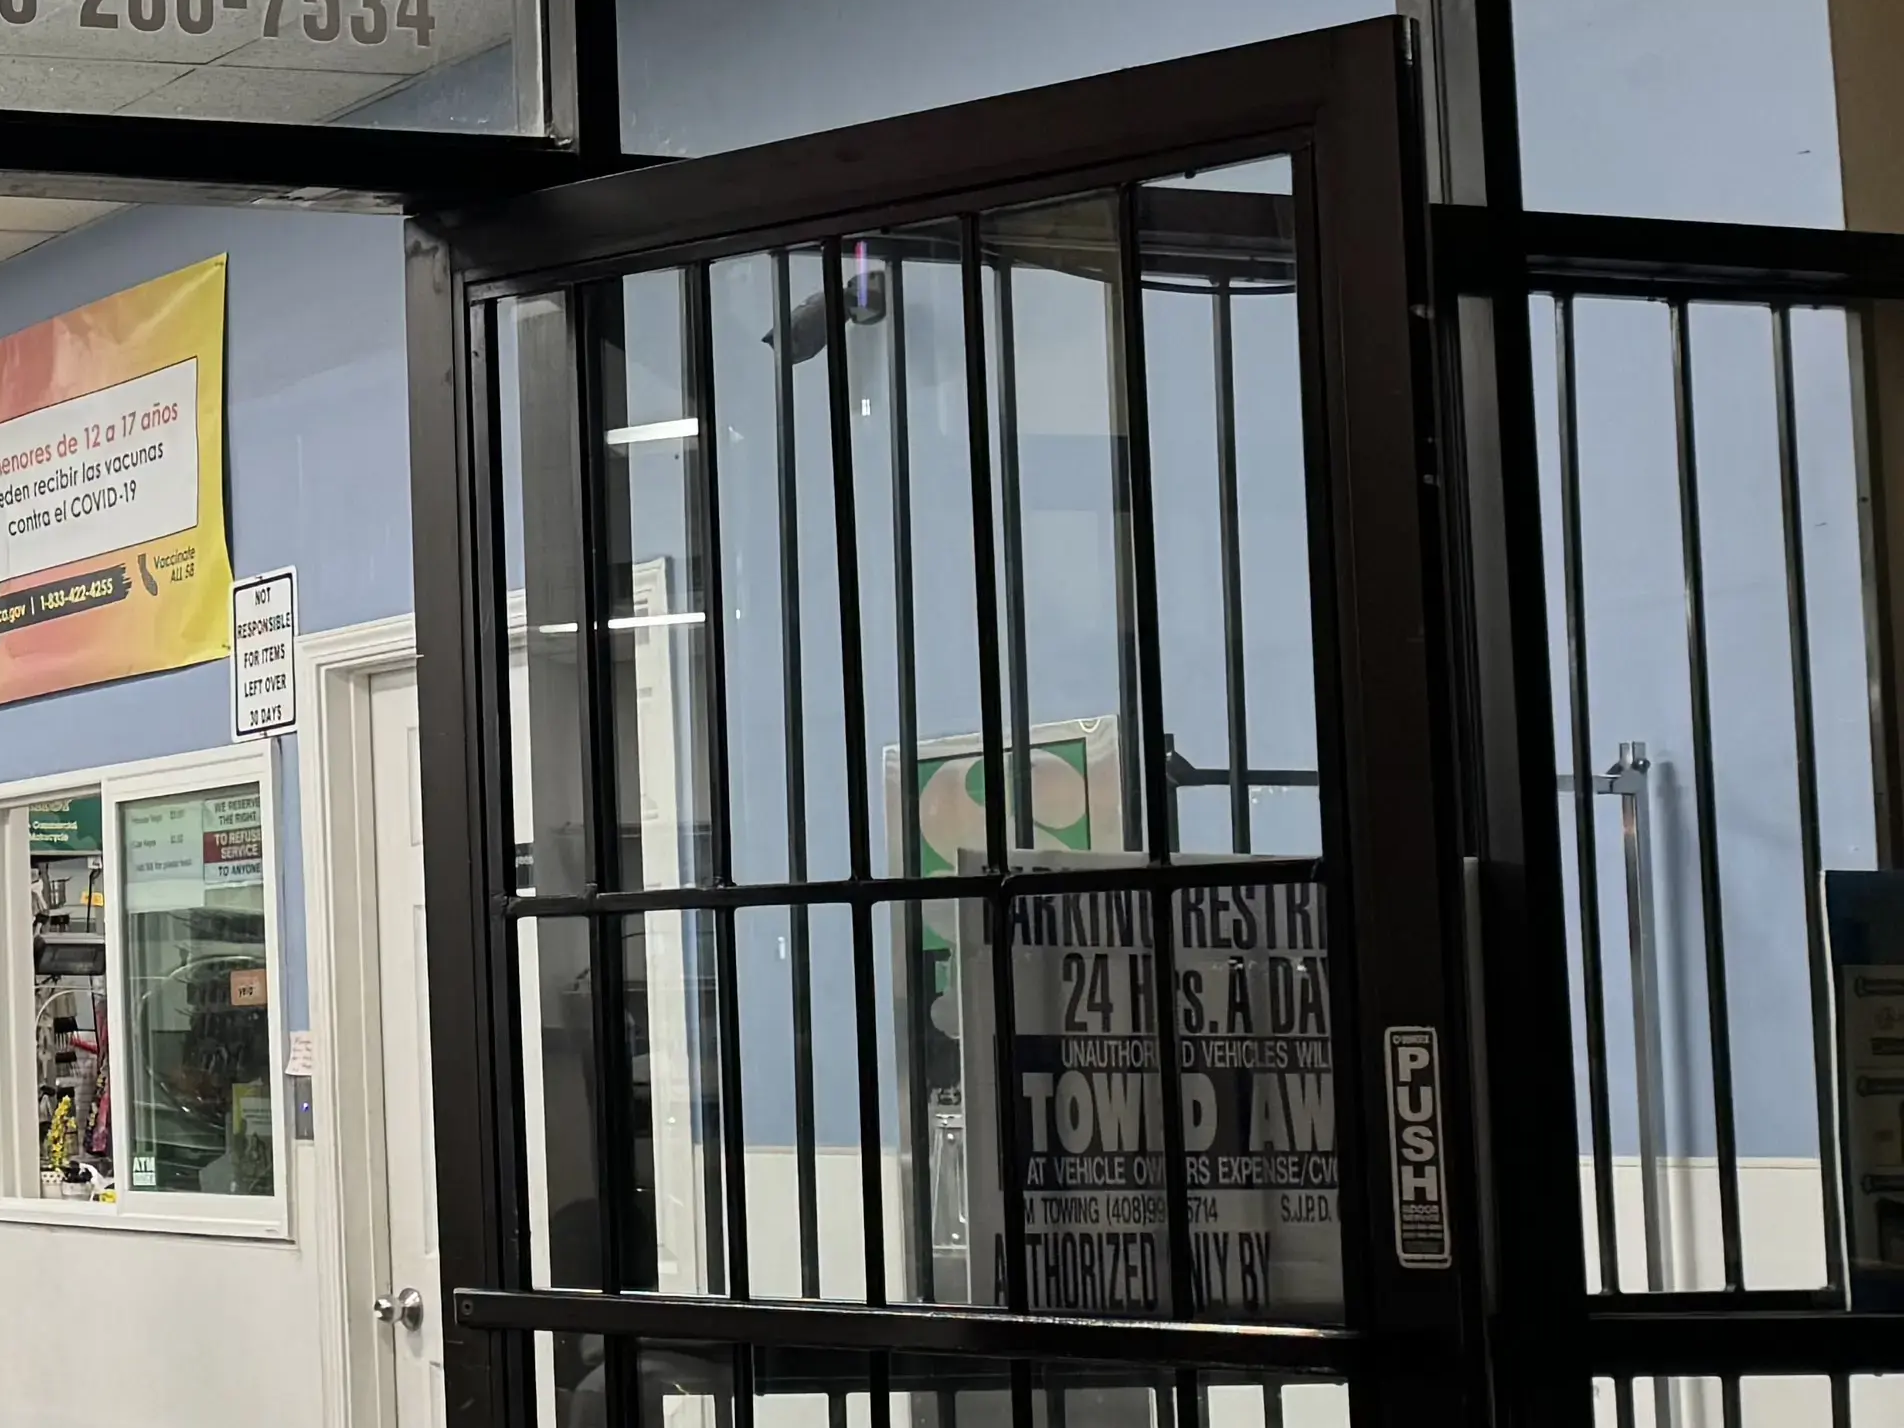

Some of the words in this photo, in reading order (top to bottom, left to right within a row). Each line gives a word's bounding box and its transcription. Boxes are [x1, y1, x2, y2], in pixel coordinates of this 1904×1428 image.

[57, 434, 78, 459] de
[84, 424, 101, 450] 12
[106, 425, 115, 443] a
[121, 411, 136, 438] 17
[141, 402, 178, 431] años
[33, 468, 78, 498] recibir
[82, 461, 101, 483] las
[104, 441, 164, 475] vacunas
[8, 509, 51, 536] contra
[54, 501, 67, 524] el
[153, 545, 196, 570] Vaccinate
[255, 587, 271, 605] NOT
[237, 612, 291, 639] RESPONSIBLE
[244, 650, 259, 669] FOR
[261, 643, 285, 664] ITEMS
[244, 677, 263, 697] LEFT
[264, 673, 287, 693] OVER
[261, 704, 282, 722] DAYS
[219, 813, 234, 826] THE
[235, 810, 258, 824] RIGHT
[214, 832, 231, 846] TO
[220, 844, 259, 860] SERVICE
[218, 865, 230, 876] TO
[1062, 953, 1114, 1033] 24
[1227, 956, 1253, 1034] A
[1203, 1040, 1288, 1069] VEHICLES
[1397, 1046, 1439, 1201] PUSH
[133, 1156, 156, 1172] ATM
[1026, 1156, 1048, 1185] AT
[1053, 1156, 1127, 1185] VEHICLE
[1043, 1196, 1099, 1224] TOWING
[1241, 1231, 1272, 1313] BY
